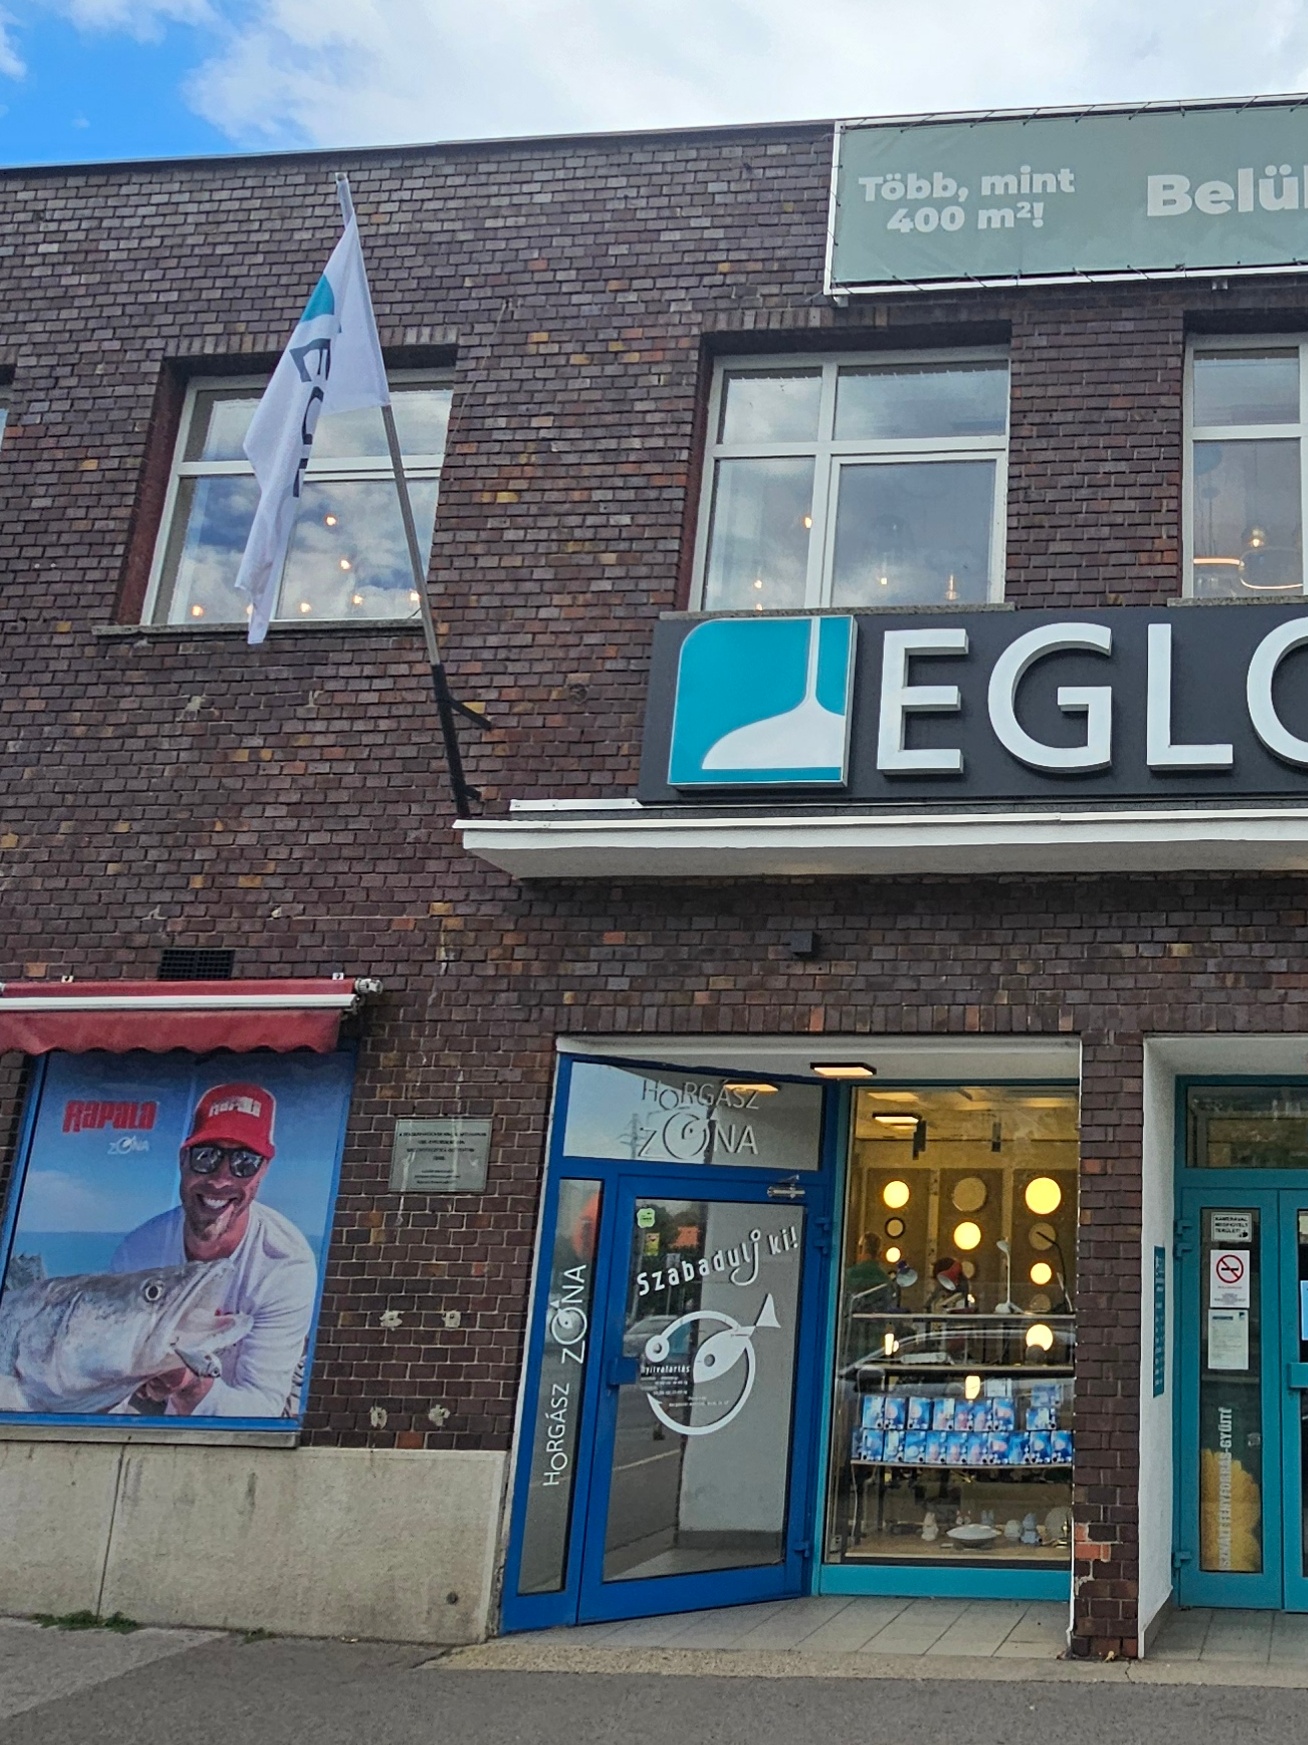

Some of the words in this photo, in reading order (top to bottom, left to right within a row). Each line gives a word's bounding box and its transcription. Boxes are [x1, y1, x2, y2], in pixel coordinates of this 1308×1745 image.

[858, 170, 969, 202] Több,
[981, 165, 1075, 197] mint
[887, 205, 965, 233] 400
[642, 1079, 759, 1110] HORGÁSZ
[637, 1229, 761, 1296] Szabadulj
[768, 1226, 799, 1255] ki!
[543, 1383, 570, 1486] HORGÁSZ
